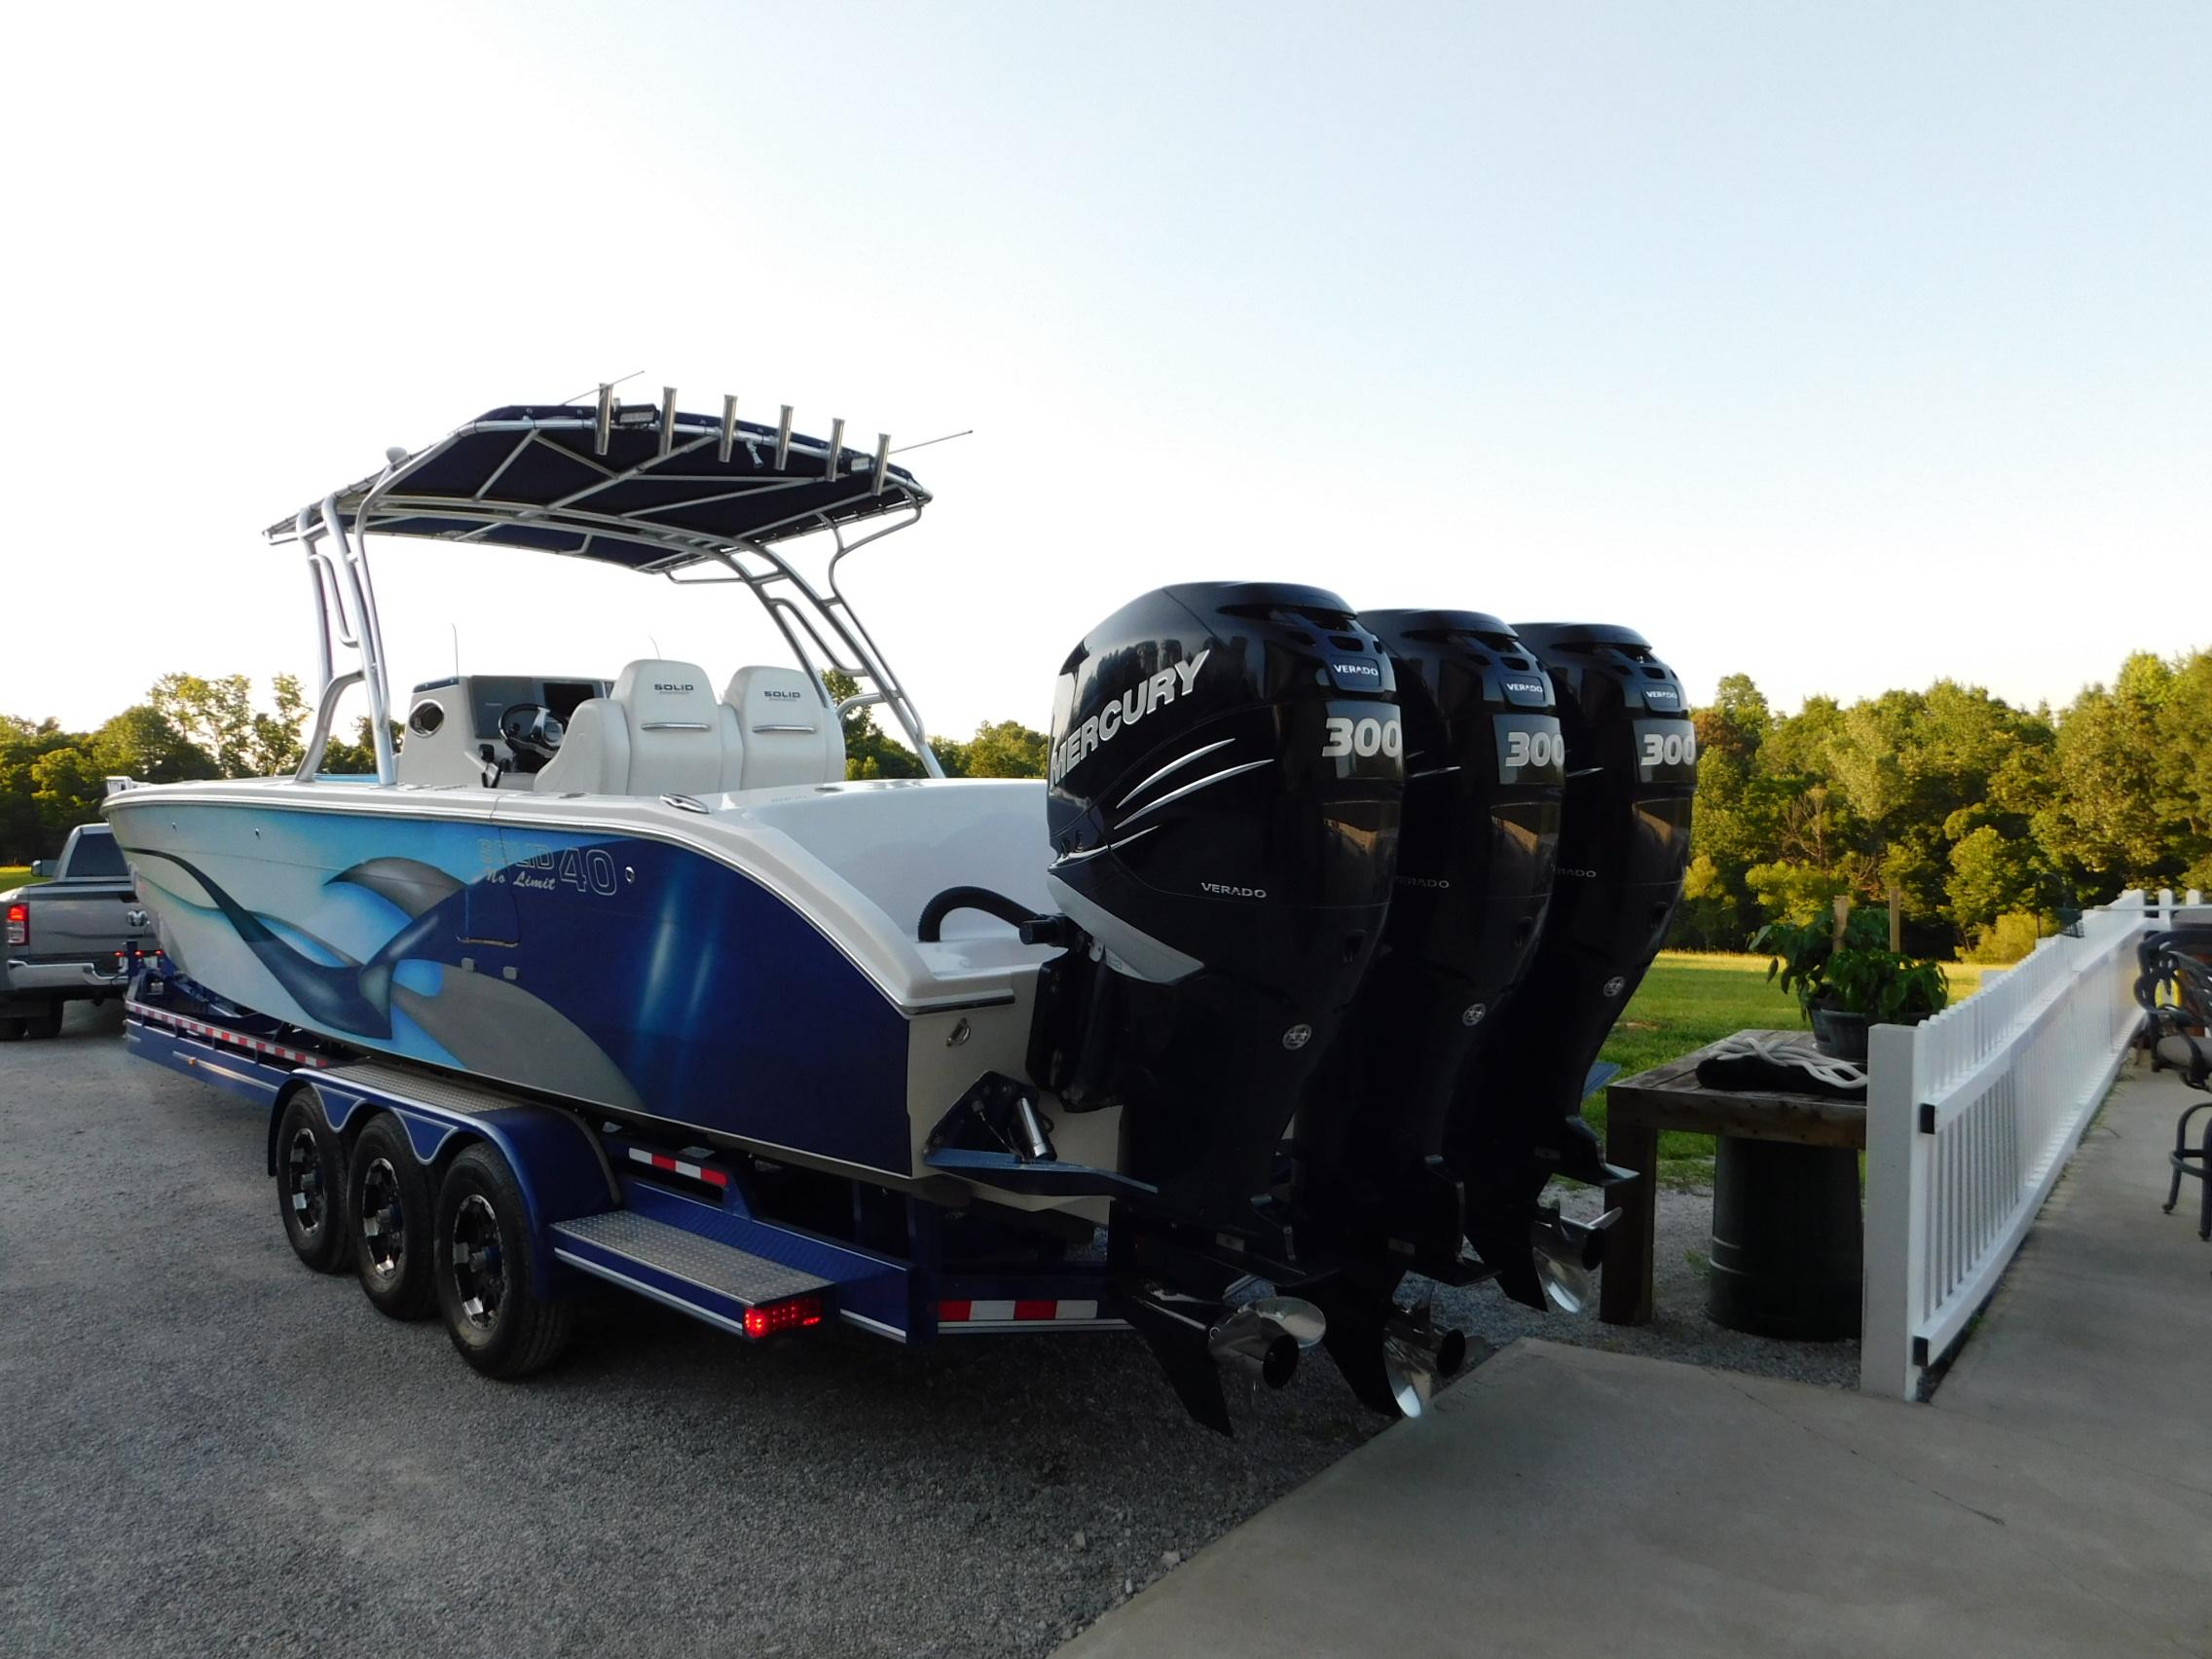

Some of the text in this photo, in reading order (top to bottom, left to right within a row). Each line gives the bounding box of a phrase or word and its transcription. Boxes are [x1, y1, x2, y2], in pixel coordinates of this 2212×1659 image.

[1333, 664, 1379, 677] VERADO
[763, 690, 801, 699] SOLID
[1505, 682, 1543, 694] VERADO
[1645, 690, 1678, 700] VERADO
[1050, 648, 1210, 791] MERCURY
[1321, 717, 1403, 757] 300
[1505, 731, 1566, 767] 300
[1641, 733, 1696, 766] 300
[512, 870, 556, 891] Limit
[558, 847, 617, 896] 40
[1200, 882, 1268, 899] VERADO
